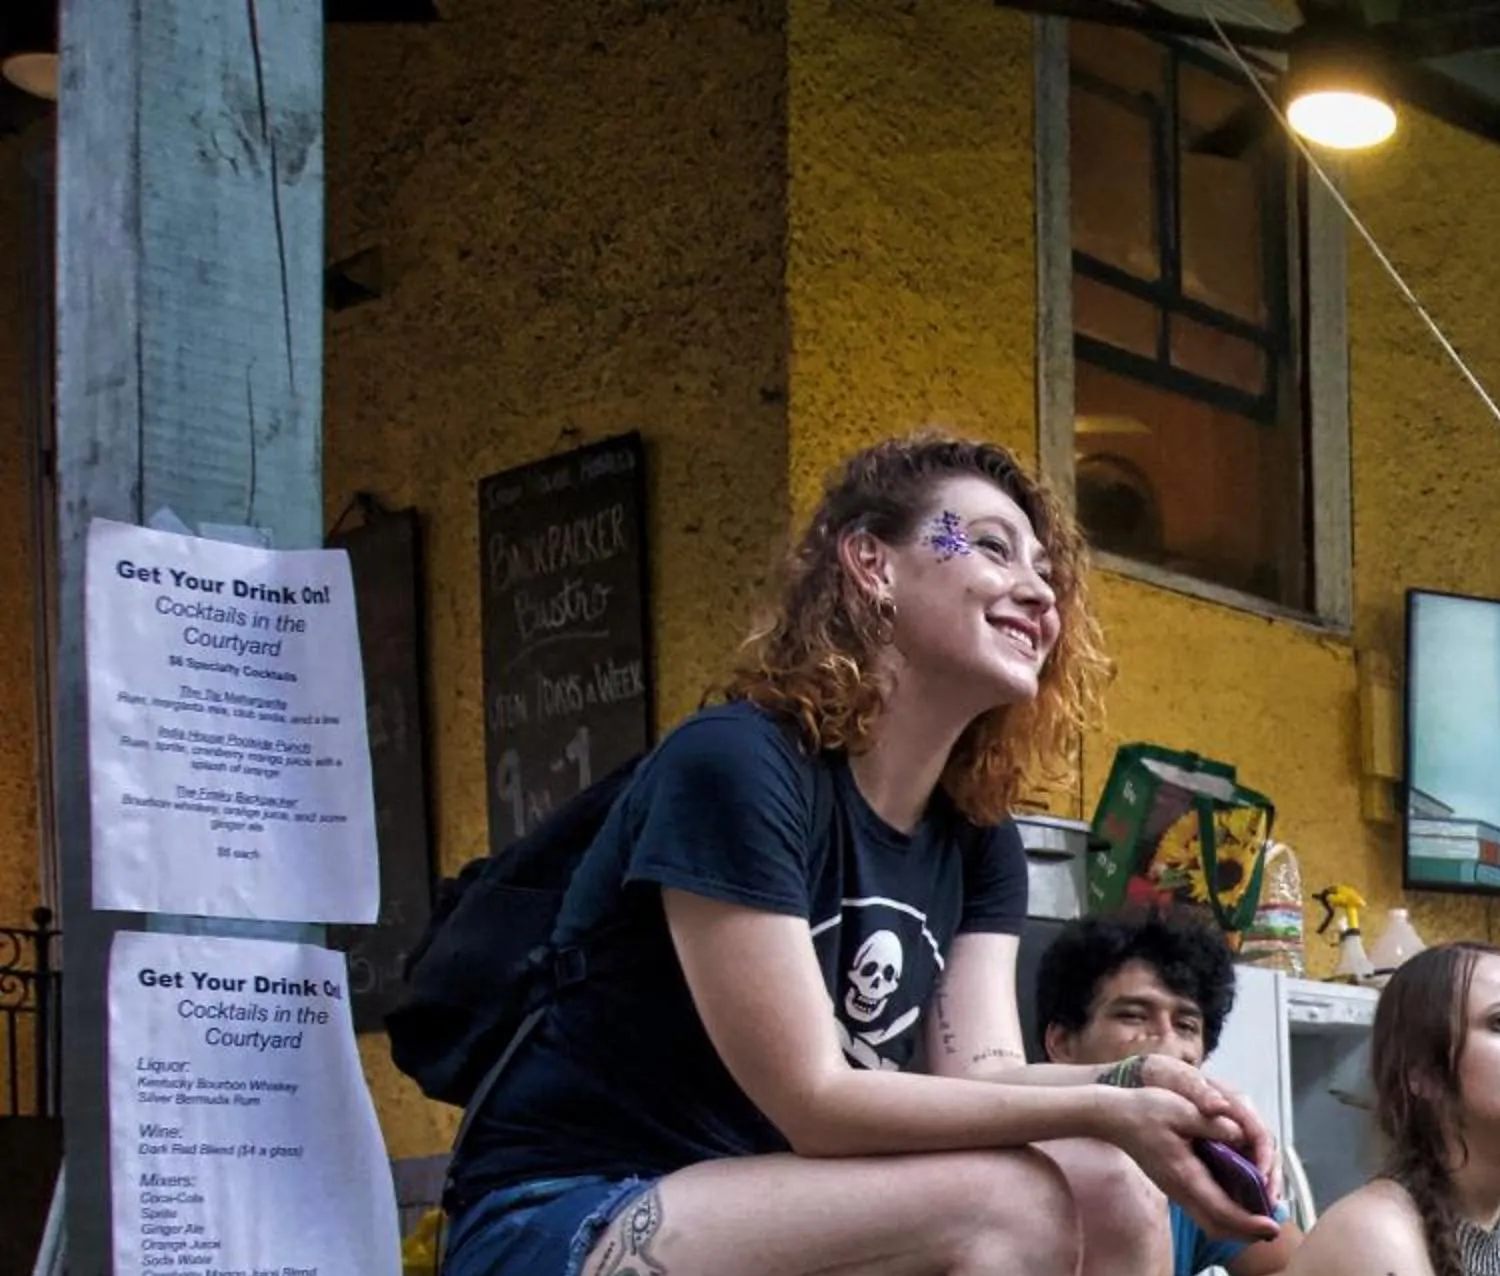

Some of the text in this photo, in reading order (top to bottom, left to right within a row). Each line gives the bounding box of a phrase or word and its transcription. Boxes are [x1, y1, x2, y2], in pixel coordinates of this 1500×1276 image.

[116, 560, 331, 605] Get Your Drink On!
[155, 596, 305, 633] Cocktails in the
[183, 626, 282, 657] Courtyard
[138, 969, 184, 989] Get
[192, 971, 246, 993] Your
[254, 976, 318, 997] Drink
[178, 999, 329, 1025] Cocktails in the
[205, 1027, 302, 1052] Courtyard
[137, 1057, 191, 1074] Liquor:
[138, 1123, 183, 1138] Wine:
[139, 1173, 197, 1188] Mixers:
